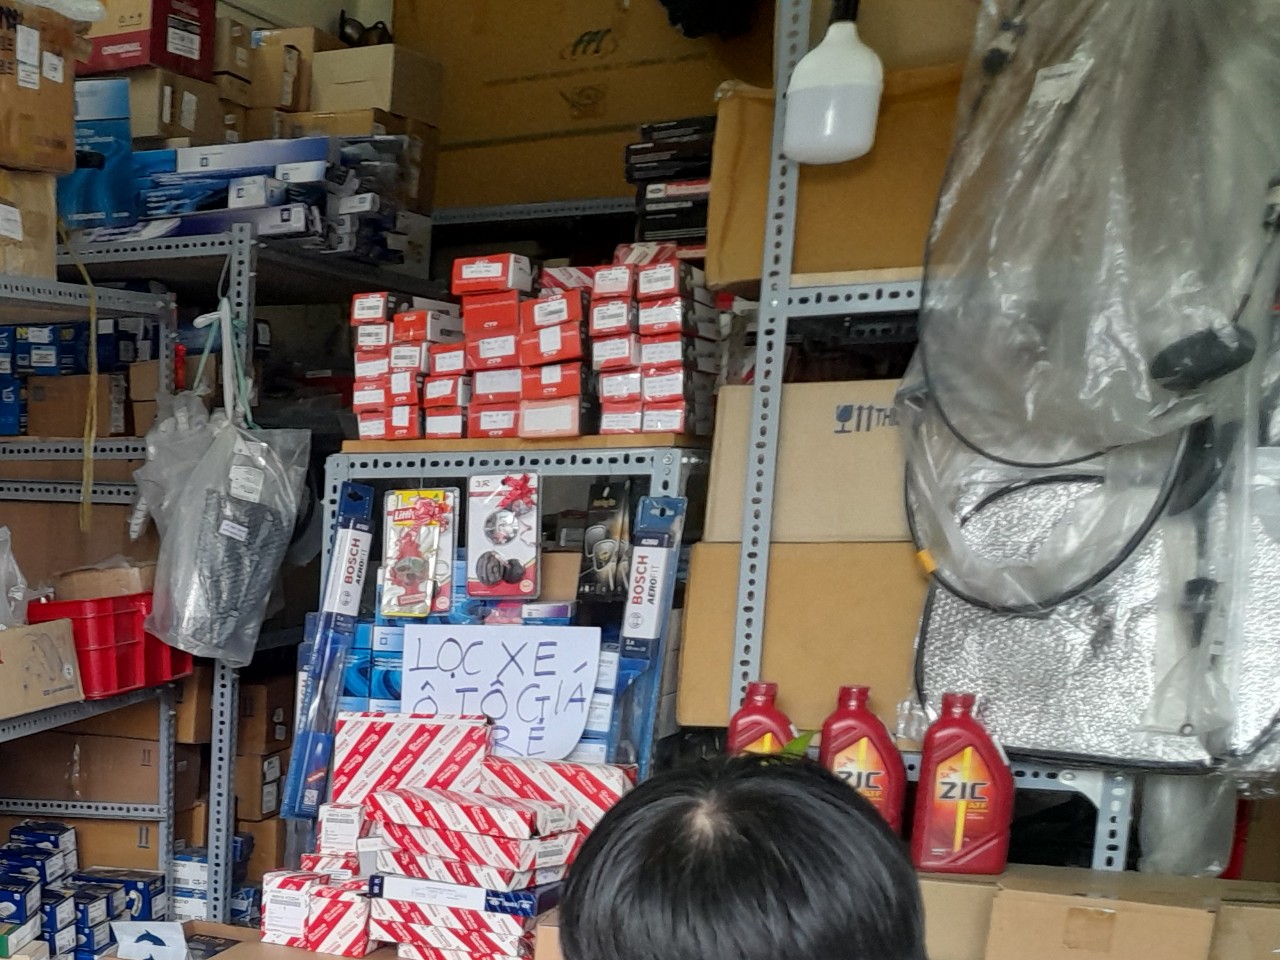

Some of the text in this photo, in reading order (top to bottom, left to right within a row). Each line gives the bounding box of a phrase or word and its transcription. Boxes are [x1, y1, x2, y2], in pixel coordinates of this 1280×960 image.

[344, 538, 361, 585] BOSCH
[356, 549, 368, 585] AEROFIT
[632, 555, 649, 605] BOSCH
[647, 564, 660, 605] AEROFIT
[409, 638, 558, 679] LỌC XE
[836, 770, 883, 790] ZIC
[939, 781, 990, 802] ZIC
[967, 802, 988, 810] ATF
